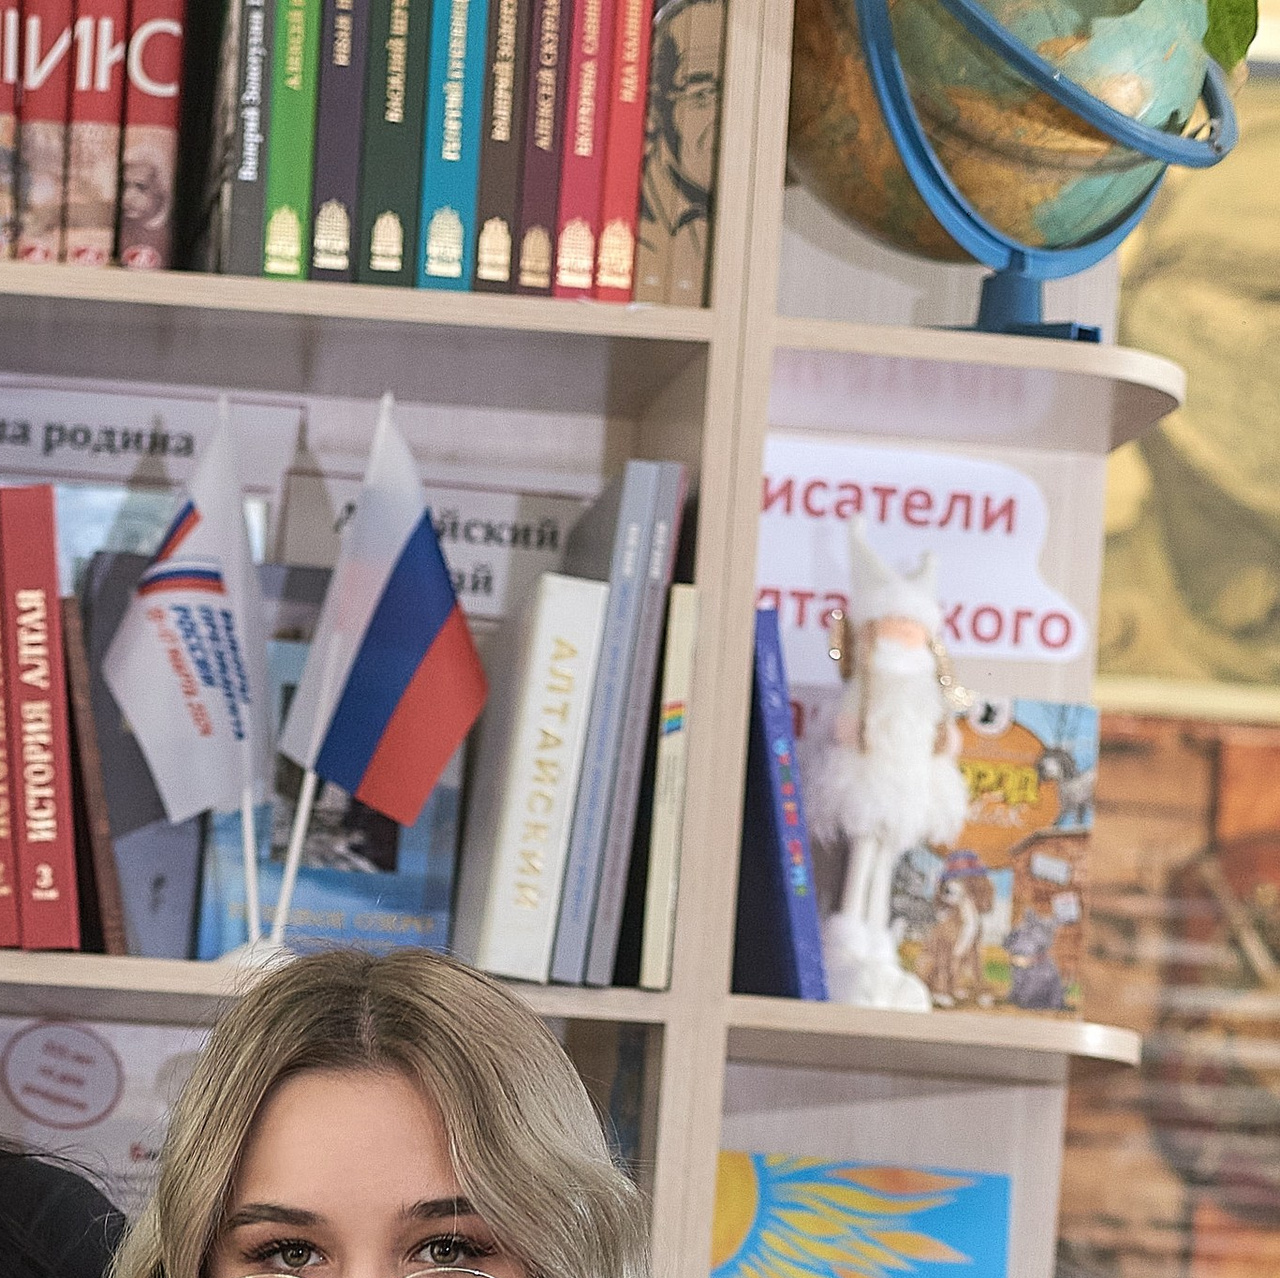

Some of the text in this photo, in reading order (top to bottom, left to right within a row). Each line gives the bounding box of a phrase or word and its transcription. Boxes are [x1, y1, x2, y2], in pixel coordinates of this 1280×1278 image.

[42, 421, 197, 458] родина
[760, 475, 1018, 536] исатели
[15, 587, 58, 842] ИСТОРИЯ АЛТАЯ
